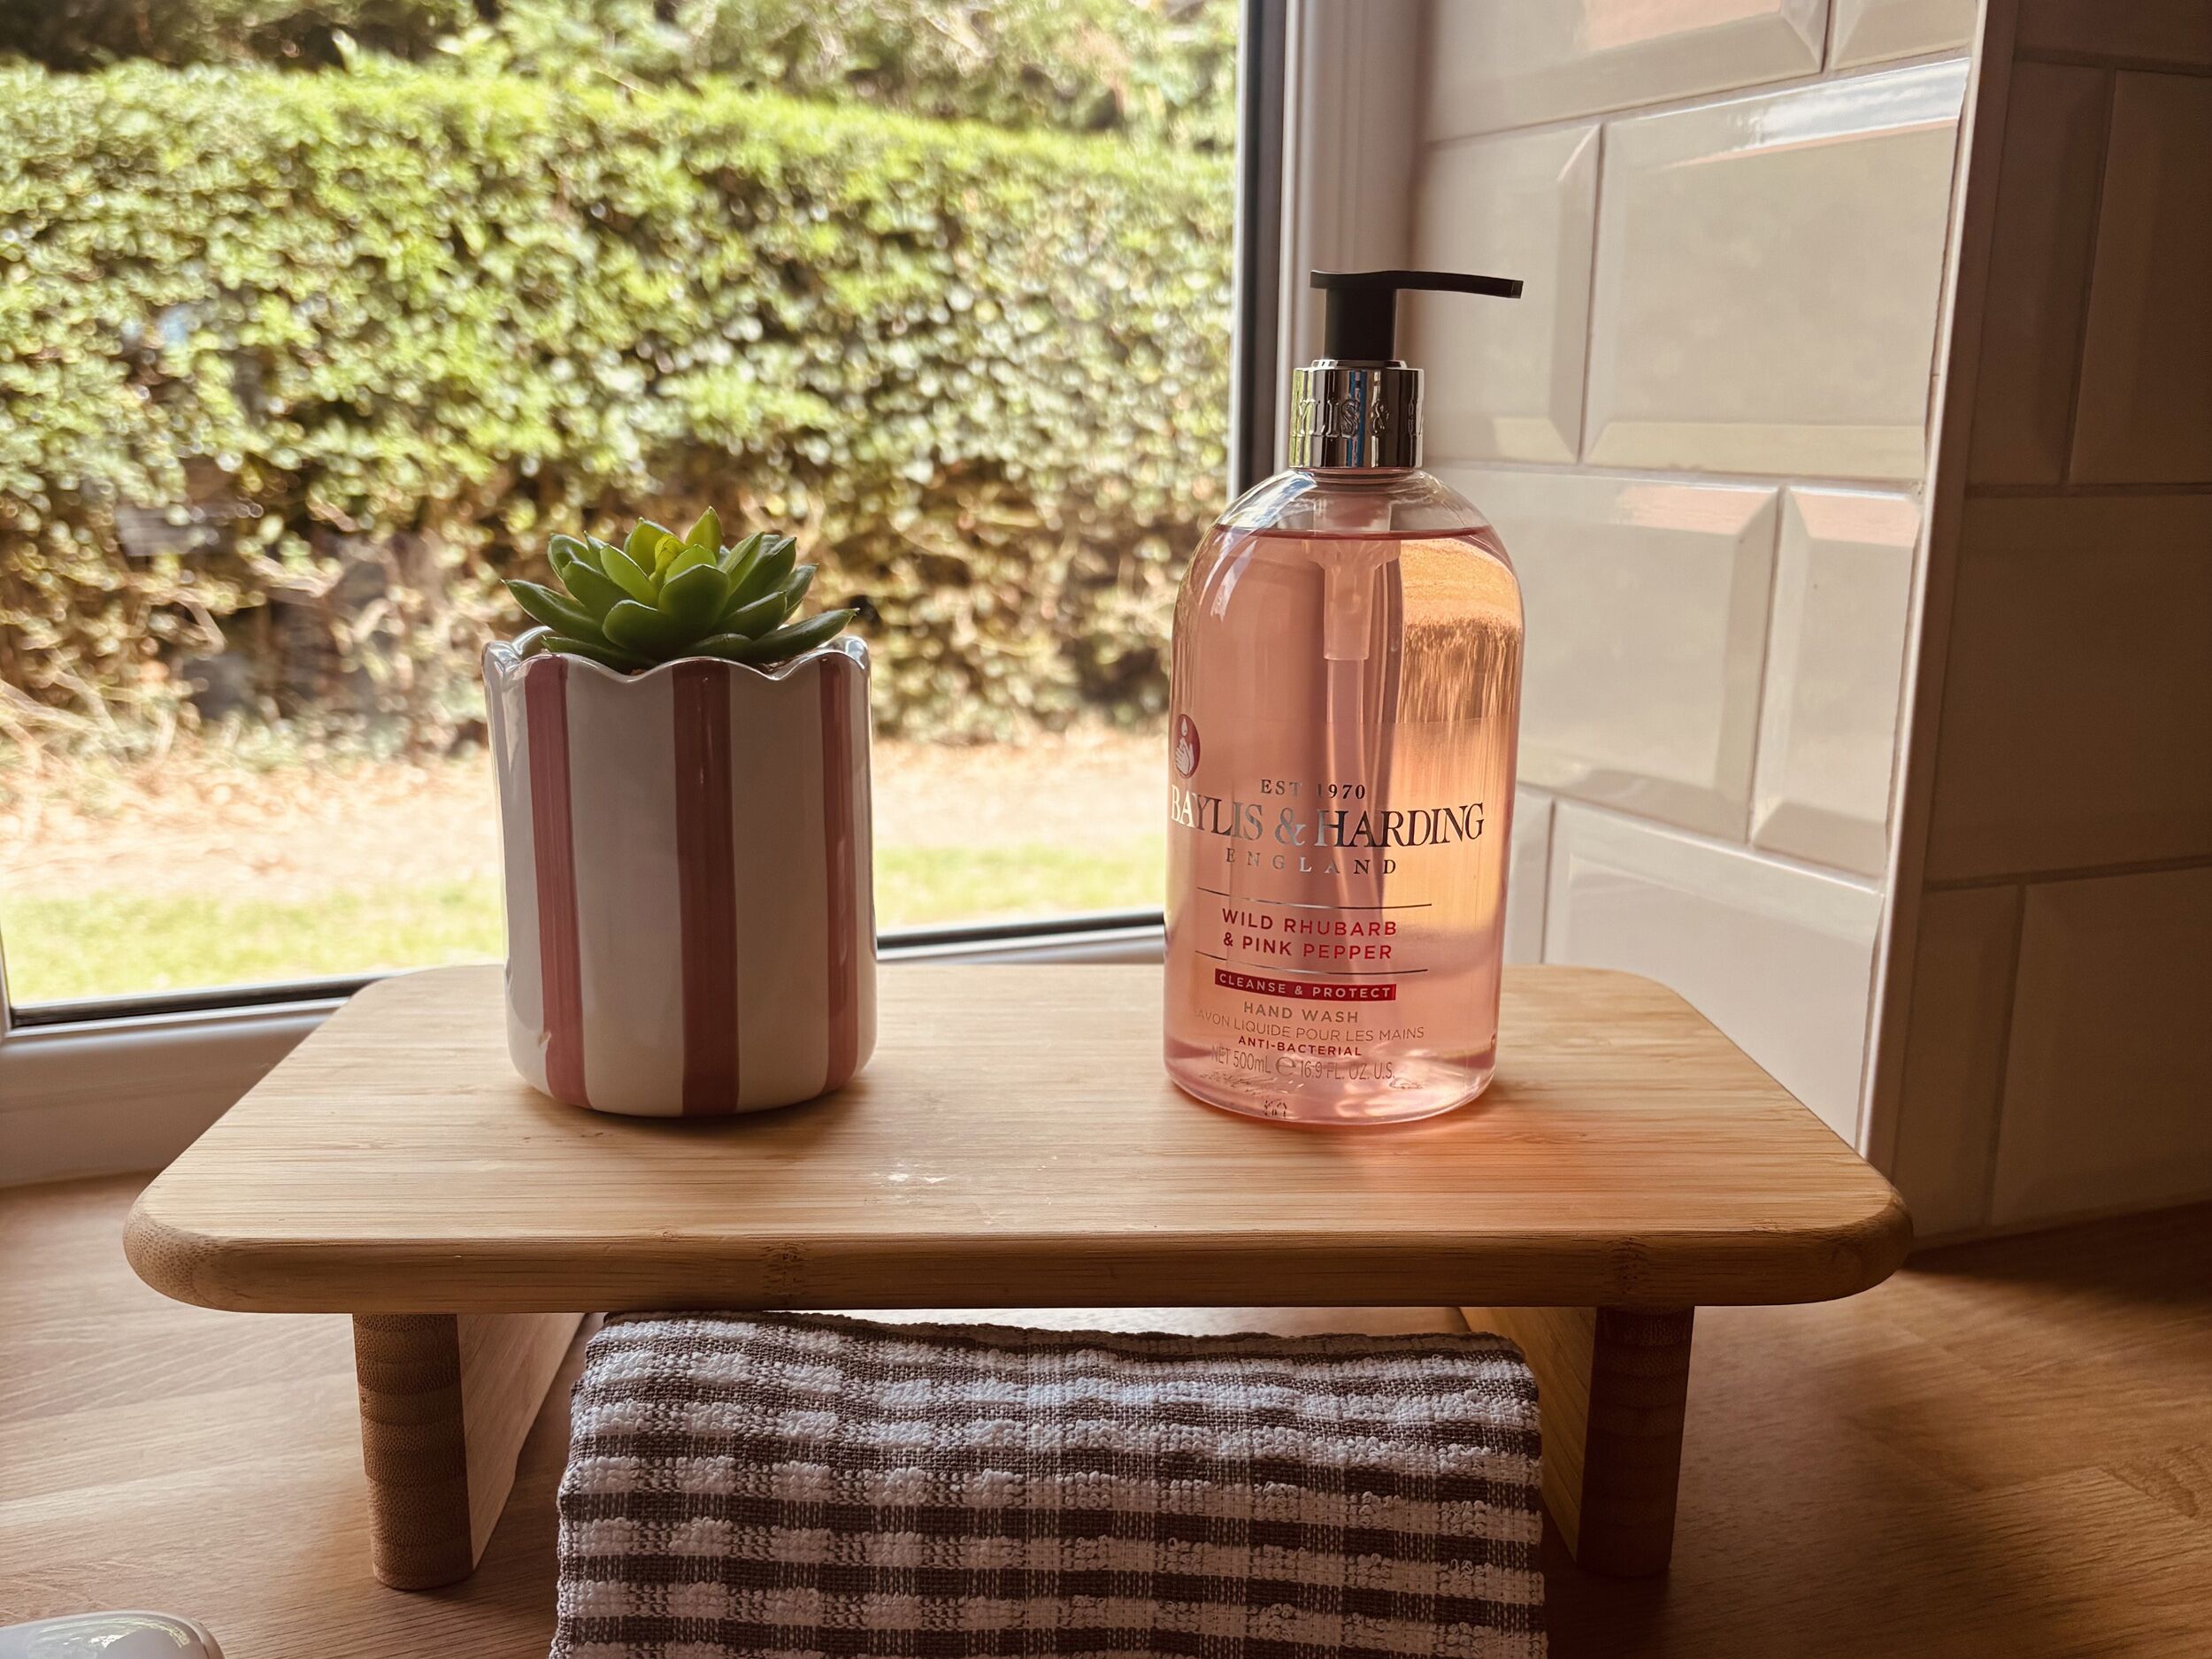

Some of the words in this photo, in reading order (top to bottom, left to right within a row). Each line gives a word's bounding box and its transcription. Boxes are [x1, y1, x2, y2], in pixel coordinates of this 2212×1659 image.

[1261, 779, 1302, 796] EST
[1317, 783, 1365, 800] 1970
[1171, 784, 1263, 841] BAYLIS
[1274, 807, 1306, 846] &
[1314, 802, 1485, 848] HARDING
[1226, 848, 1396, 875] ENGLAND
[1222, 908, 1273, 930] WILD
[1284, 918, 1397, 936] RHUBARB
[1223, 933, 1233, 948] &
[1242, 936, 1292, 956] PINK
[1302, 943, 1393, 960] PEPPER
[1218, 972, 1286, 995] CLEANSE
[1294, 986, 1303, 995] &
[1312, 987, 1391, 999] PROTECT
[1244, 1002, 1292, 1019] HAND
[1302, 1010, 1358, 1023] WASH
[1234, 1018, 1291, 1038] LIQUIDE
[1296, 1027, 1340, 1041] POUR
[1346, 1030, 1373, 1041] LES
[1379, 1026, 1425, 1041] MAINS
[1239, 1035, 1362, 1056] ANTI-BACTERIAL
[1211, 1044, 1231, 1064] NET
[1233, 1050, 1271, 1073] 500mL
[1327, 1062, 1345, 1079] FL.
[1349, 1063, 1370, 1080] OZ.
[1374, 1062, 1395, 1079] U.S.
